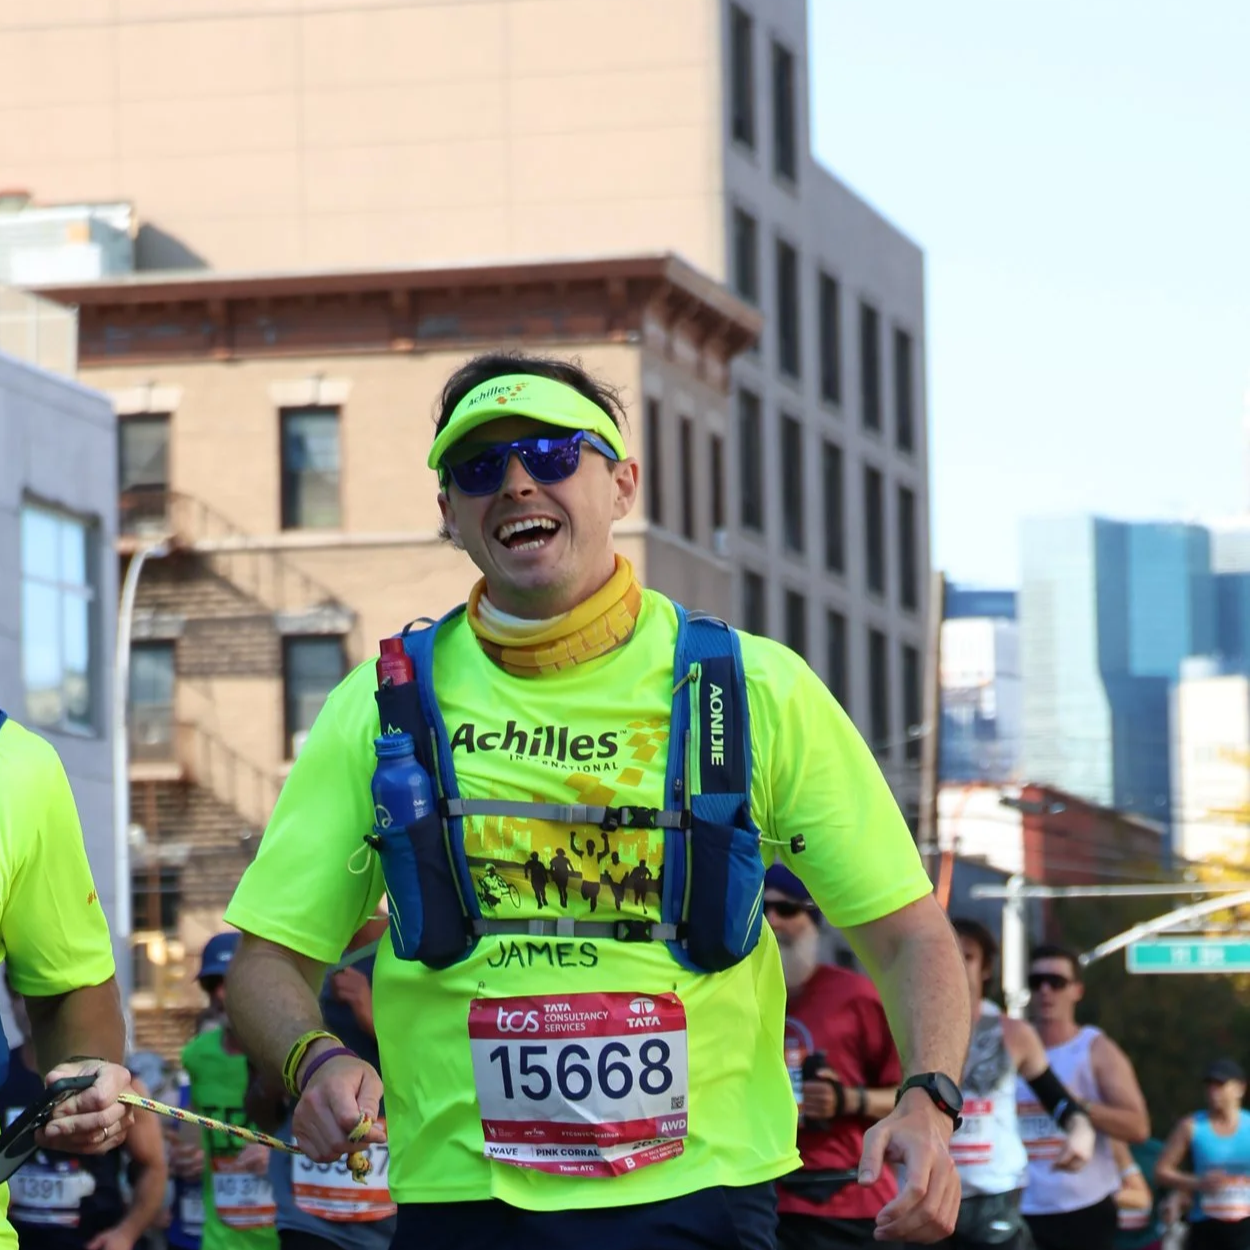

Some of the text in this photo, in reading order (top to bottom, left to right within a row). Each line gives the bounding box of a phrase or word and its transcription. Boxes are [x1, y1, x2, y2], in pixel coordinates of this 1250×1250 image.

[467, 386, 511, 409] Achilles
[709, 682, 725, 767] AONIJIE
[450, 720, 619, 762] Achilles
[487, 940, 599, 969] JAMES
[543, 1003, 571, 1013] TATA
[496, 1006, 540, 1033] tcs
[544, 1011, 609, 1022] CONSULTANCY
[626, 1016, 661, 1028] TATA
[544, 1023, 586, 1033] SERVICES
[489, 1038, 674, 1102] 15668
[661, 1119, 687, 1133] AWD
[489, 1146, 601, 1157] WAVE PINK CORRAL
[580, 1164, 595, 1172] ATC
[624, 1157, 636, 1170] B
